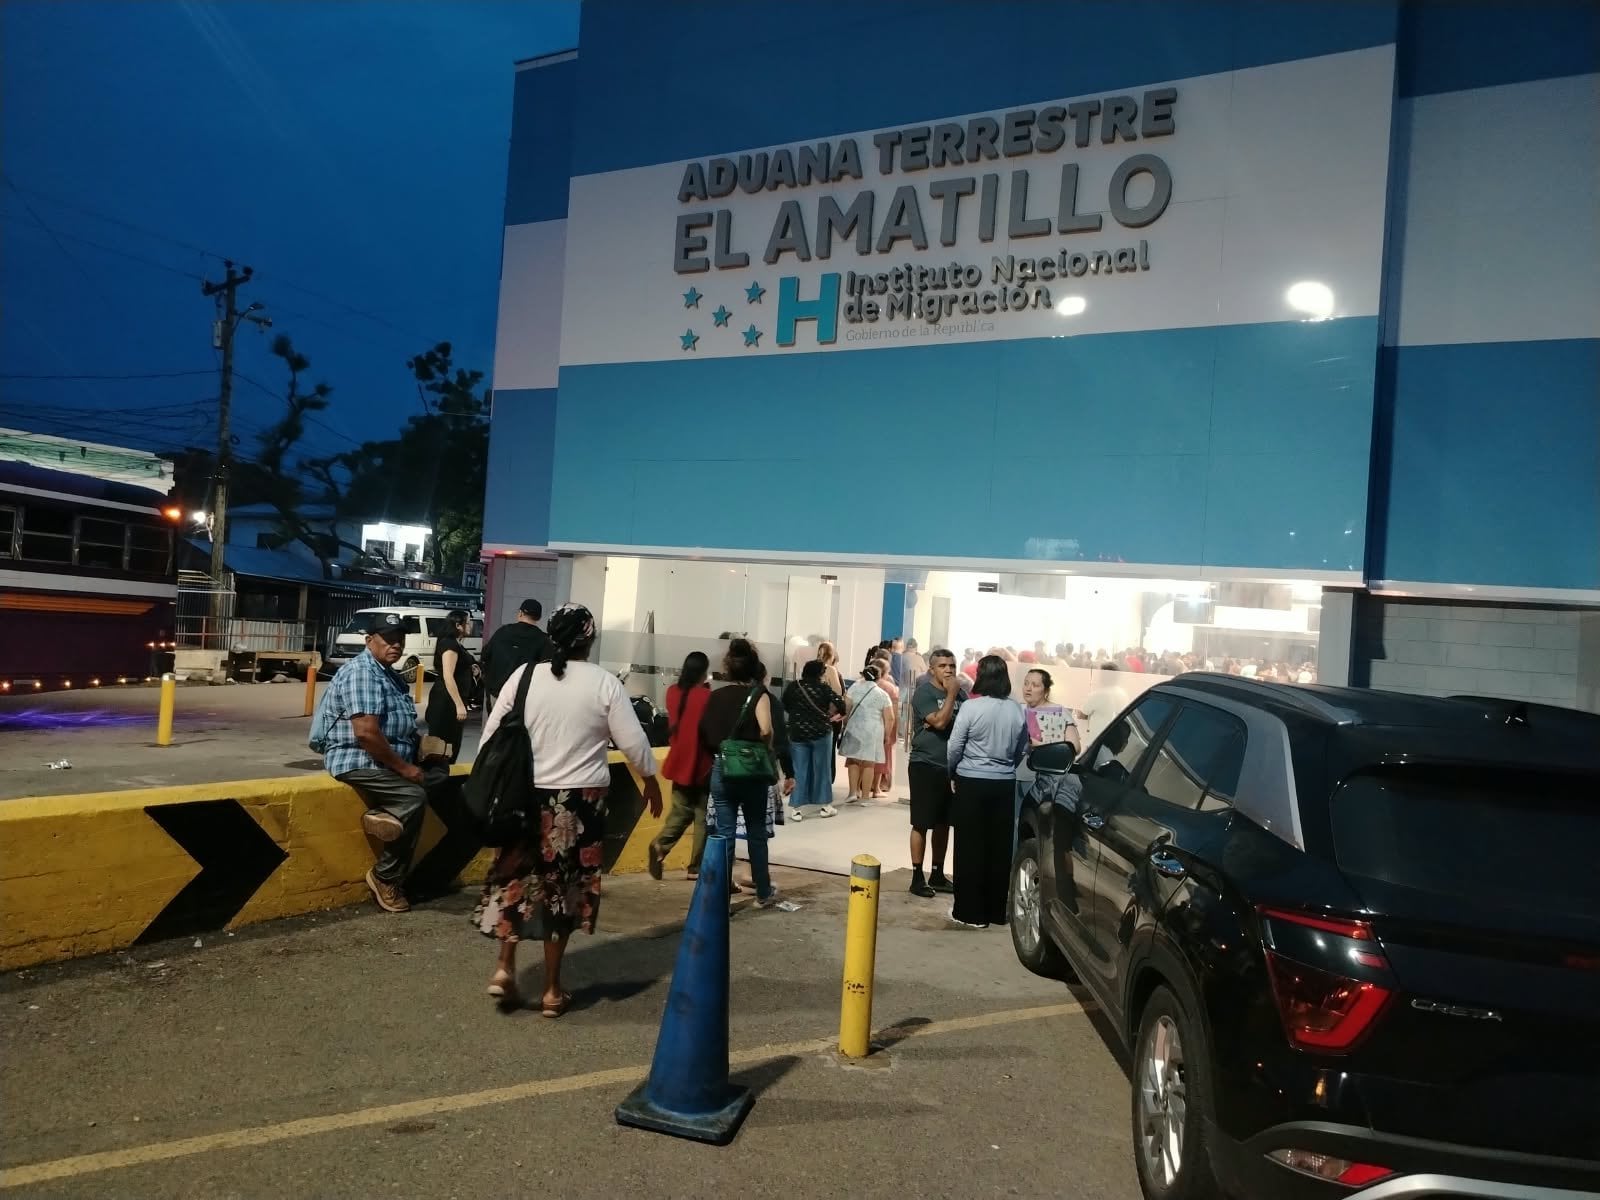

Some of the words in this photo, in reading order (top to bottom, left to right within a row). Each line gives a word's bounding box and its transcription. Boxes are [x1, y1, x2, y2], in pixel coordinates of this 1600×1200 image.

[677, 138, 862, 202] ADUANA
[873, 87, 1178, 174] TERRESTRE
[673, 208, 749, 273] EL
[762, 153, 1173, 264] AMATILLO
[846, 263, 982, 297] Instituto
[991, 240, 1150, 284] Nacional
[775, 272, 841, 346] H
[843, 297, 880, 323] de
[885, 282, 1052, 323] Migración
[846, 327, 900, 342] Gobierno
[902, 325, 918, 338] de
[919, 324, 930, 336] la
